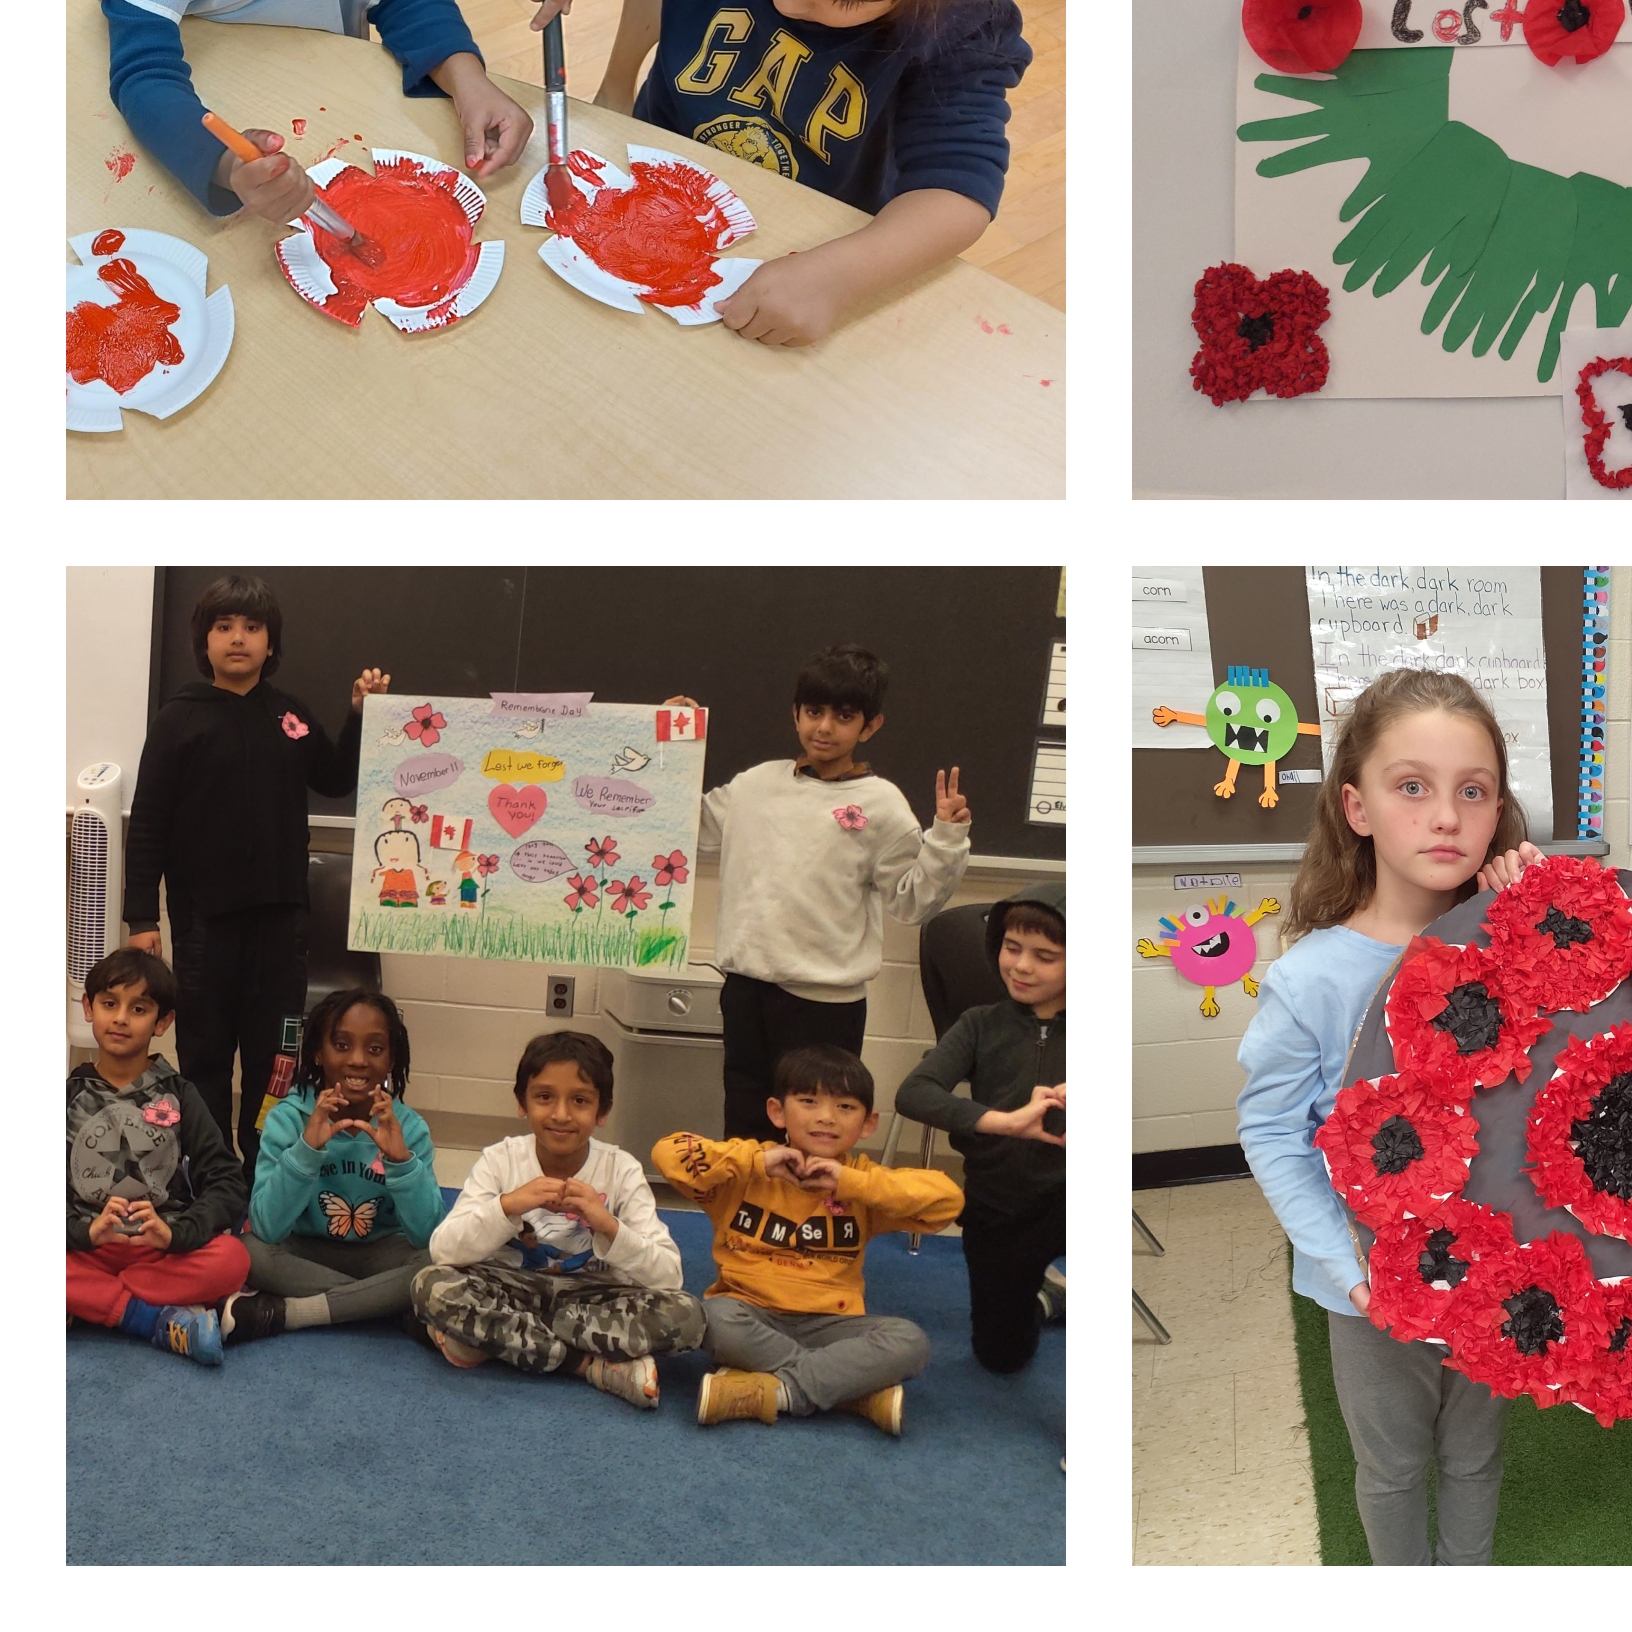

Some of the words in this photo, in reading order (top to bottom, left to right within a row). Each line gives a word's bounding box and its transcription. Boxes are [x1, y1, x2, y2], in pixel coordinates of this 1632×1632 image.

[674, 7, 869, 166] GAP
[699, 121, 741, 141] STRONGER
[771, 139, 791, 179] TOGETHE
[1142, 585, 1172, 596] corn
[1336, 566, 1367, 586] the
[1416, 567, 1460, 592] dark
[1467, 575, 1508, 593] room
[1378, 598, 1409, 612] was
[1414, 599, 1425, 613] a
[1473, 592, 1514, 617] dark
[1143, 634, 1180, 646] acorn
[1317, 641, 1350, 666] In
[1358, 643, 1388, 667] the
[1435, 645, 1476, 667] dark
[1473, 668, 1510, 690] dark
[561, 705, 582, 718] Day
[484, 751, 513, 773] Lest
[516, 761, 534, 770] we
[400, 768, 449, 788] November
[497, 797, 536, 809] Thank
[574, 781, 594, 798] We
[599, 786, 652, 805] Remember
[85, 1116, 166, 1149] CONESE
[738, 1210, 752, 1229] Ta
[771, 1223, 787, 1242] M
[802, 1226, 823, 1240] Se
